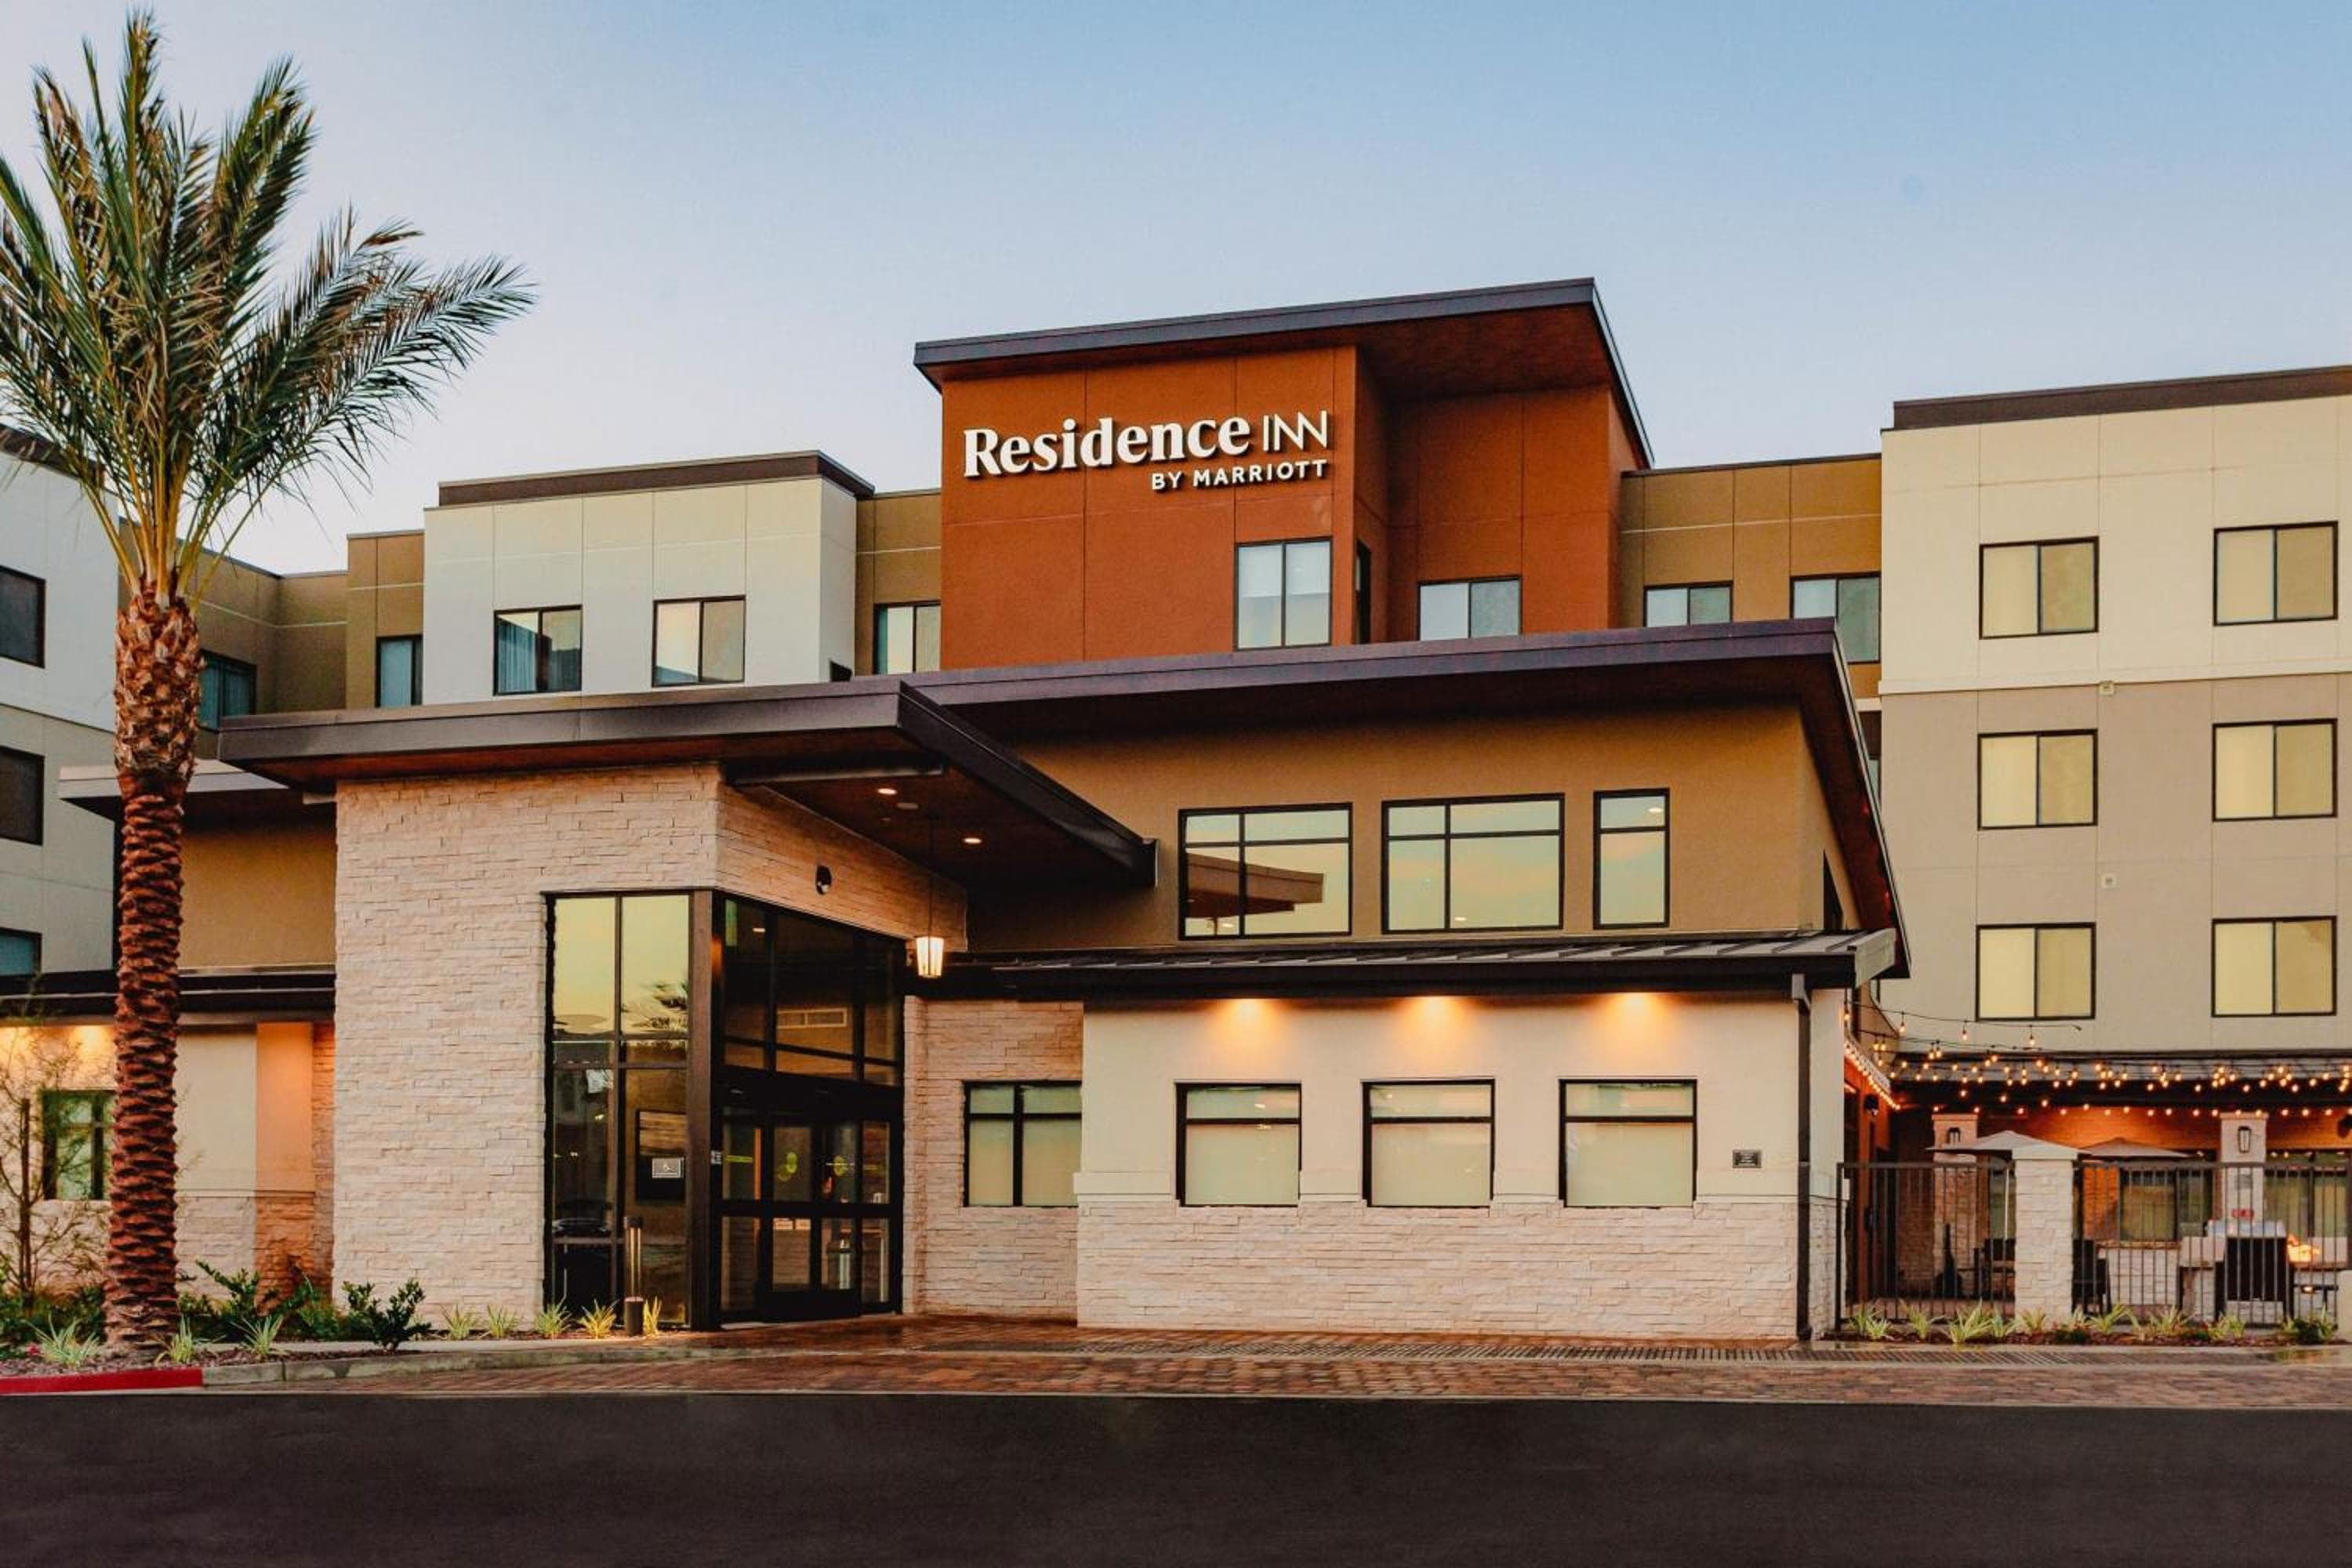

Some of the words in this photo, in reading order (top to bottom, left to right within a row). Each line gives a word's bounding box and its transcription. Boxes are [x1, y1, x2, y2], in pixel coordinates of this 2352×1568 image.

[964, 416, 1251, 477] Residence
[1263, 410, 1327, 452] INN
[1152, 472, 1182, 489] BY
[1192, 459, 1327, 487] MARRIOTT
